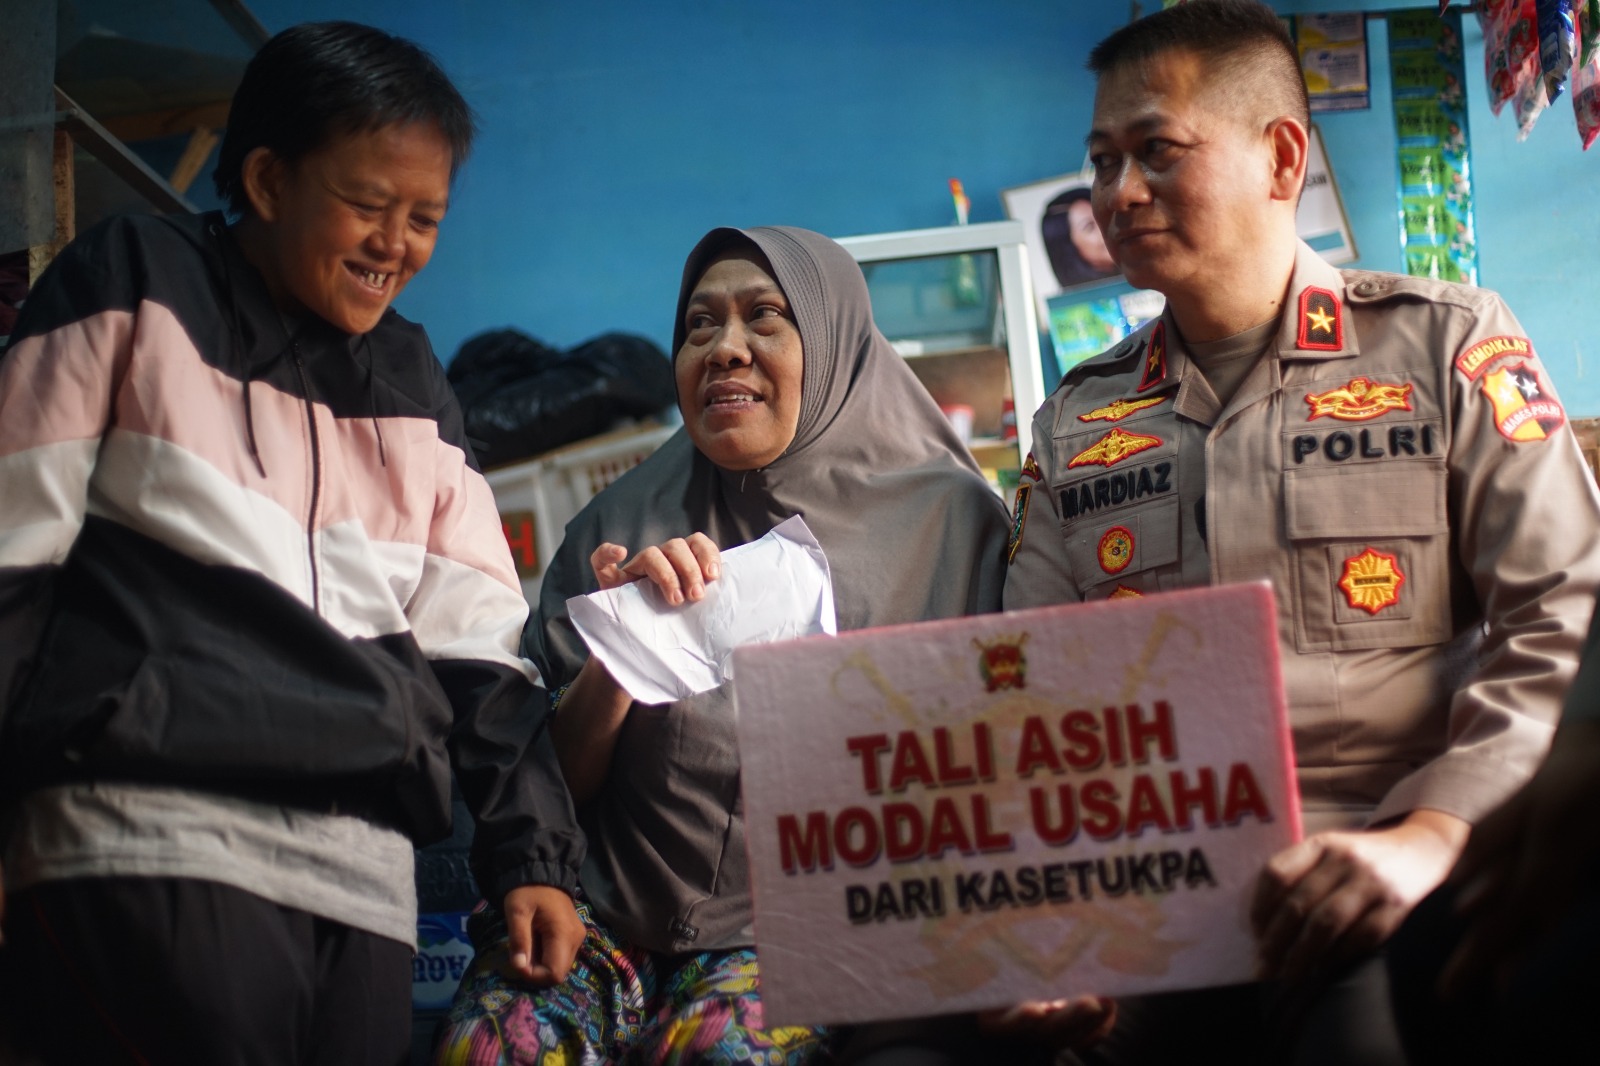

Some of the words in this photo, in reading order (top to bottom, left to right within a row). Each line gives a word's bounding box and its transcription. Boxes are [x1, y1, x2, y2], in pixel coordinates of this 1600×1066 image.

[1463, 339, 1528, 372] LEMDIKLAT
[1293, 425, 1434, 463] POLRI
[1060, 462, 1172, 520] MARDIAZ
[846, 721, 995, 795] TALI
[1015, 700, 1176, 777] ASIH
[776, 793, 1014, 875] MODAL
[1028, 762, 1273, 847] USAHA
[845, 878, 945, 923] DARI
[957, 848, 1215, 911] KASETUKPA
[412, 953, 467, 983] AQU
